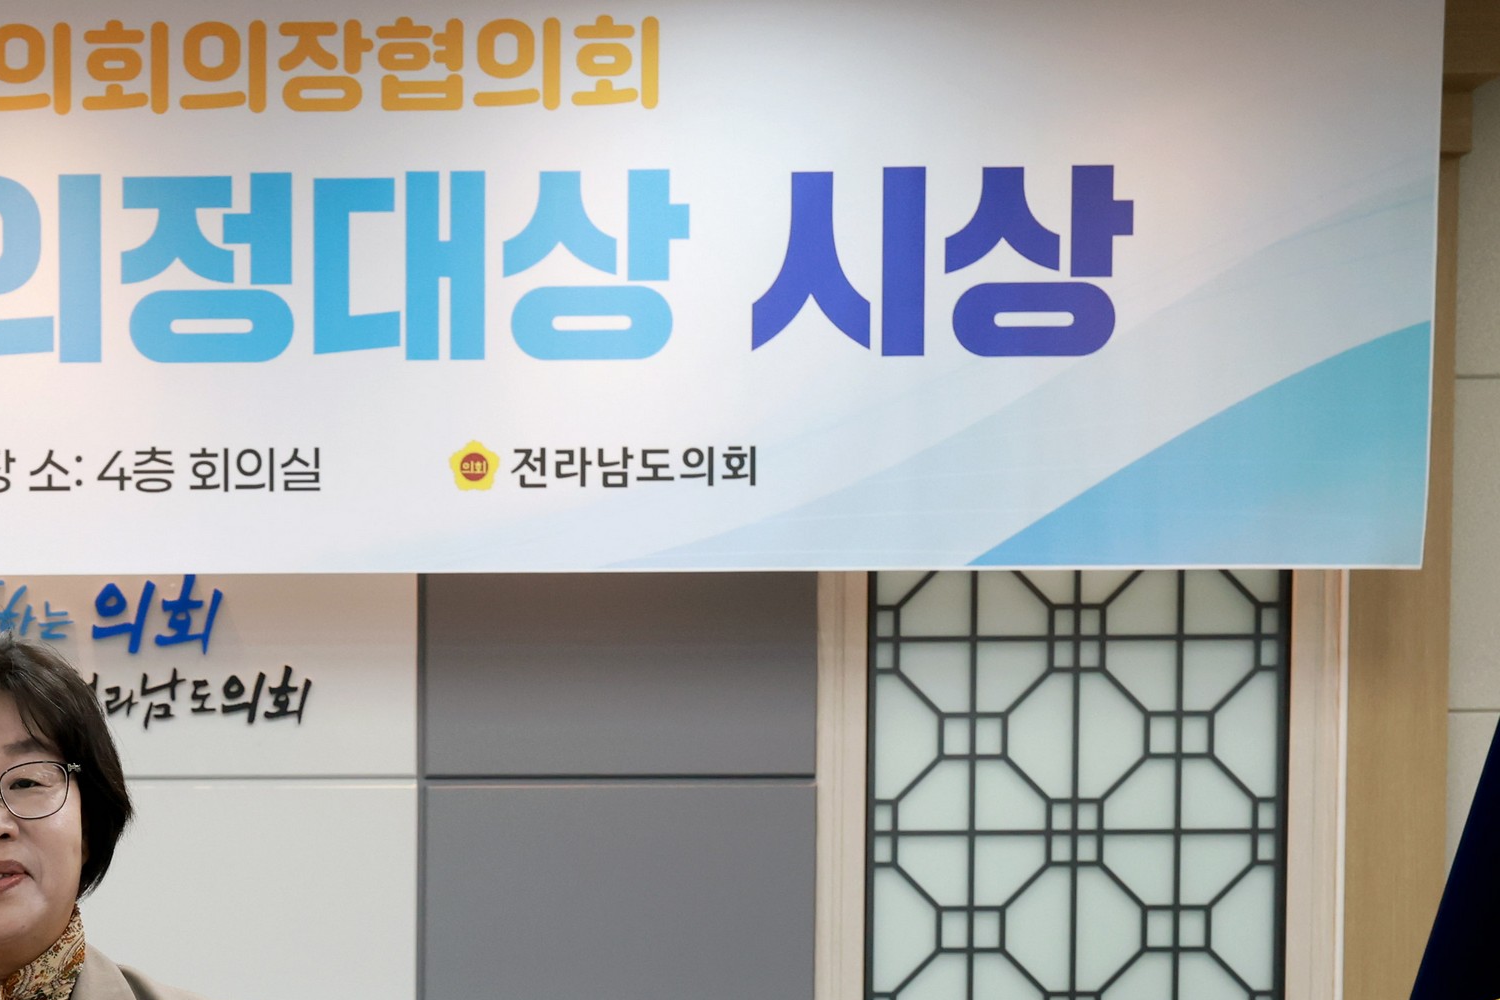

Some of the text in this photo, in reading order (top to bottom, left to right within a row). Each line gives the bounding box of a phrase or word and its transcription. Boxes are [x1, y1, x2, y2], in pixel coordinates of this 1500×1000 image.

[751, 164, 1135, 358] 시상
[28, 449, 84, 493] 소:
[96, 446, 176, 493] 4층
[189, 446, 322, 493] 회의실
[511, 445, 758, 489] 전라남도의회
[92, 574, 223, 654] 의회
[87, 664, 312, 730] 라남도의회
